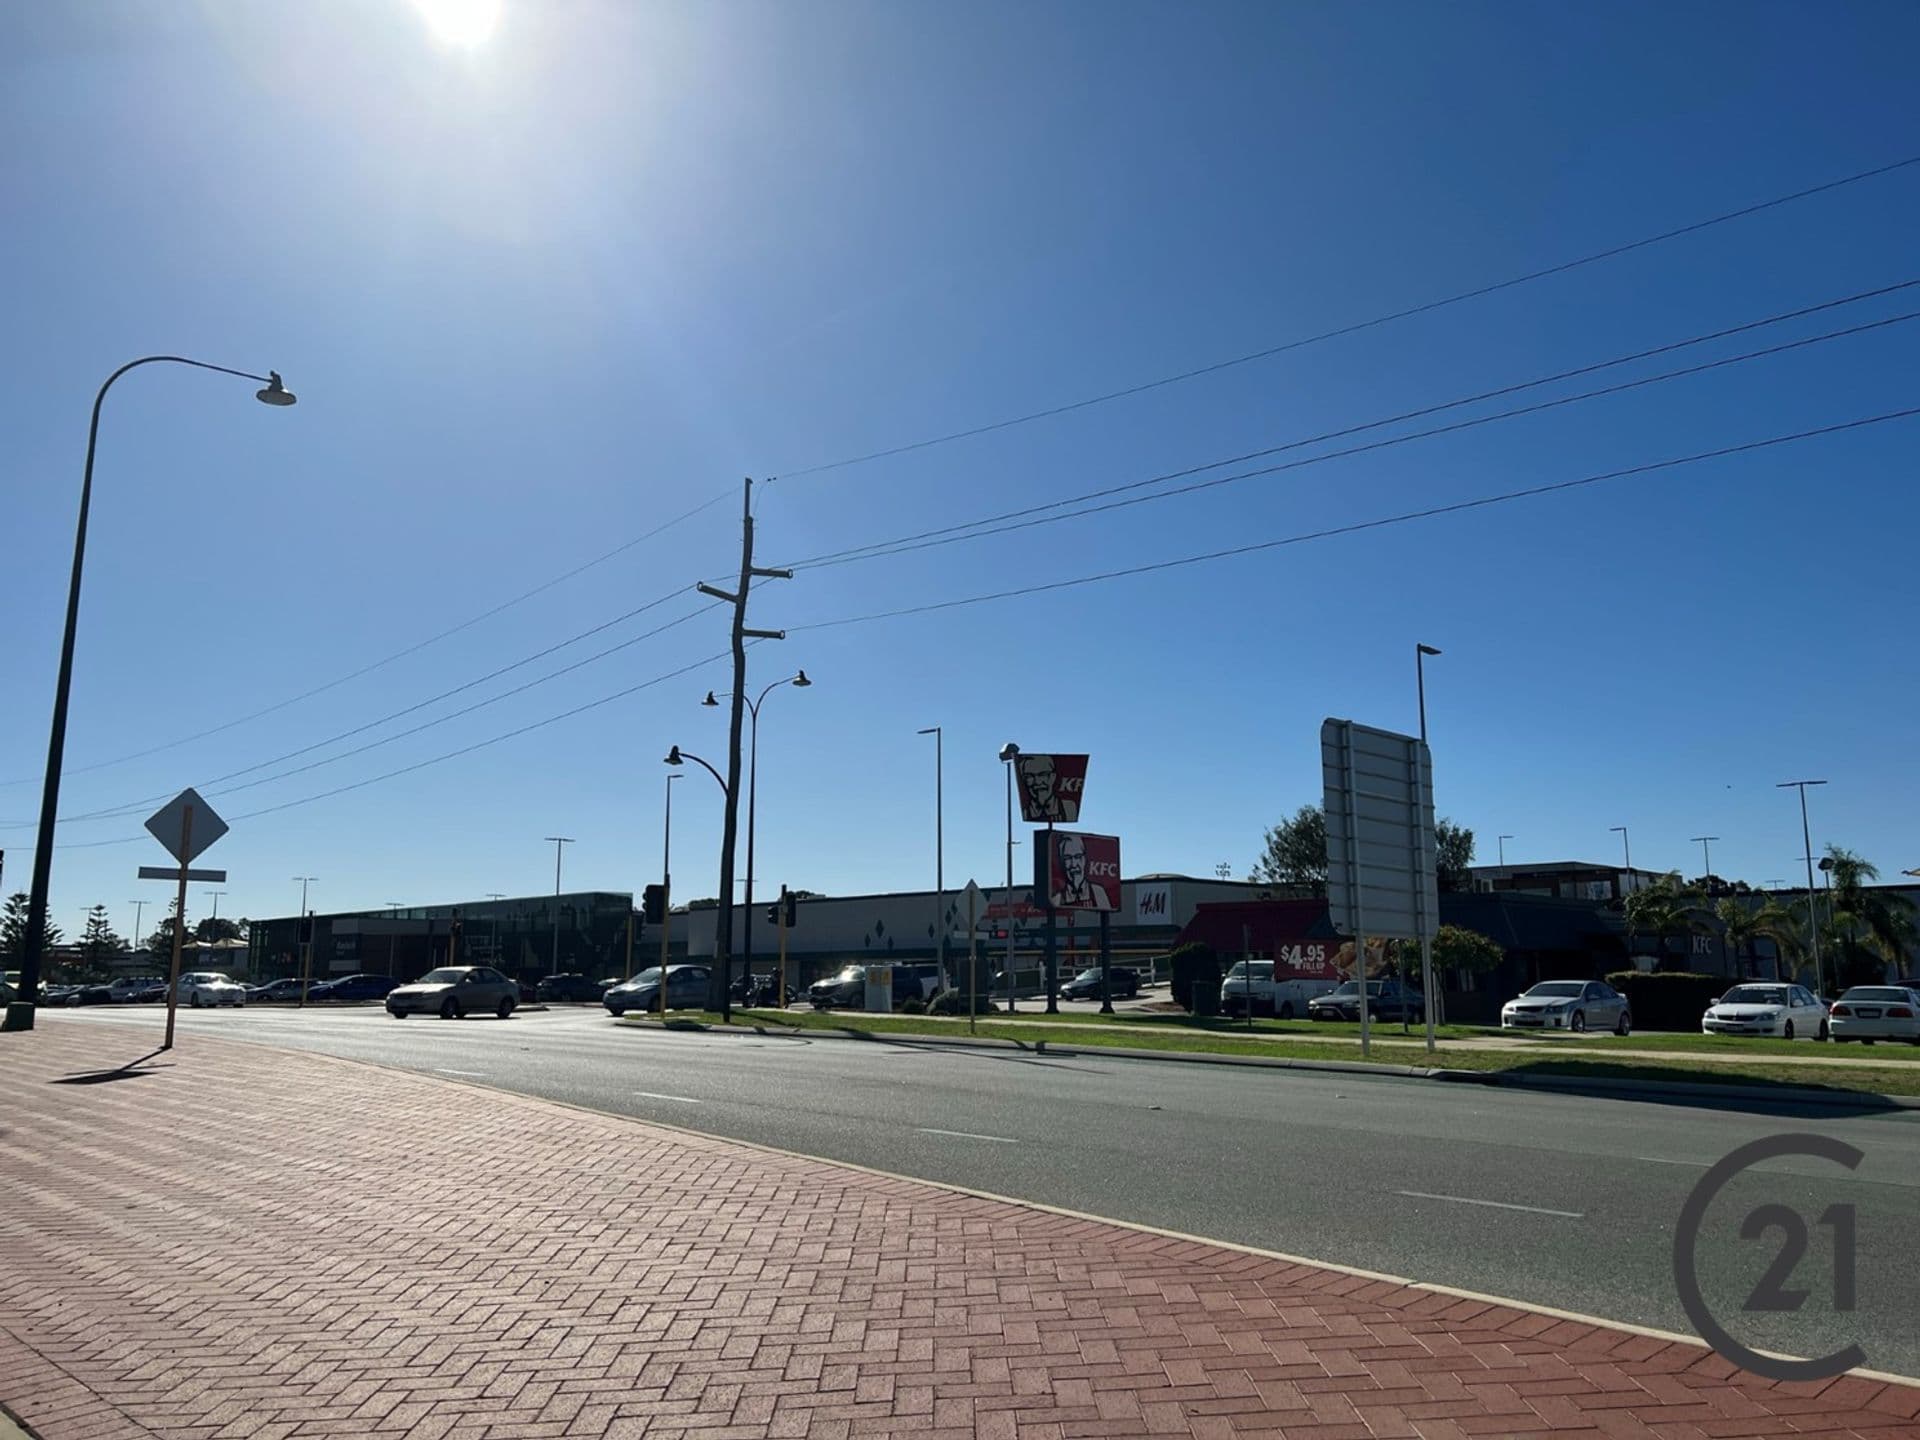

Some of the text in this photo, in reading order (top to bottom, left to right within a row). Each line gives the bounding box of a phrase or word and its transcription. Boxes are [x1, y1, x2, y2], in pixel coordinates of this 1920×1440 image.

[1089, 861, 1118, 877] KFC
[1139, 892, 1166, 915] H&M
[1692, 935, 1713, 954] KFC
[1280, 944, 1326, 970] $4.95
